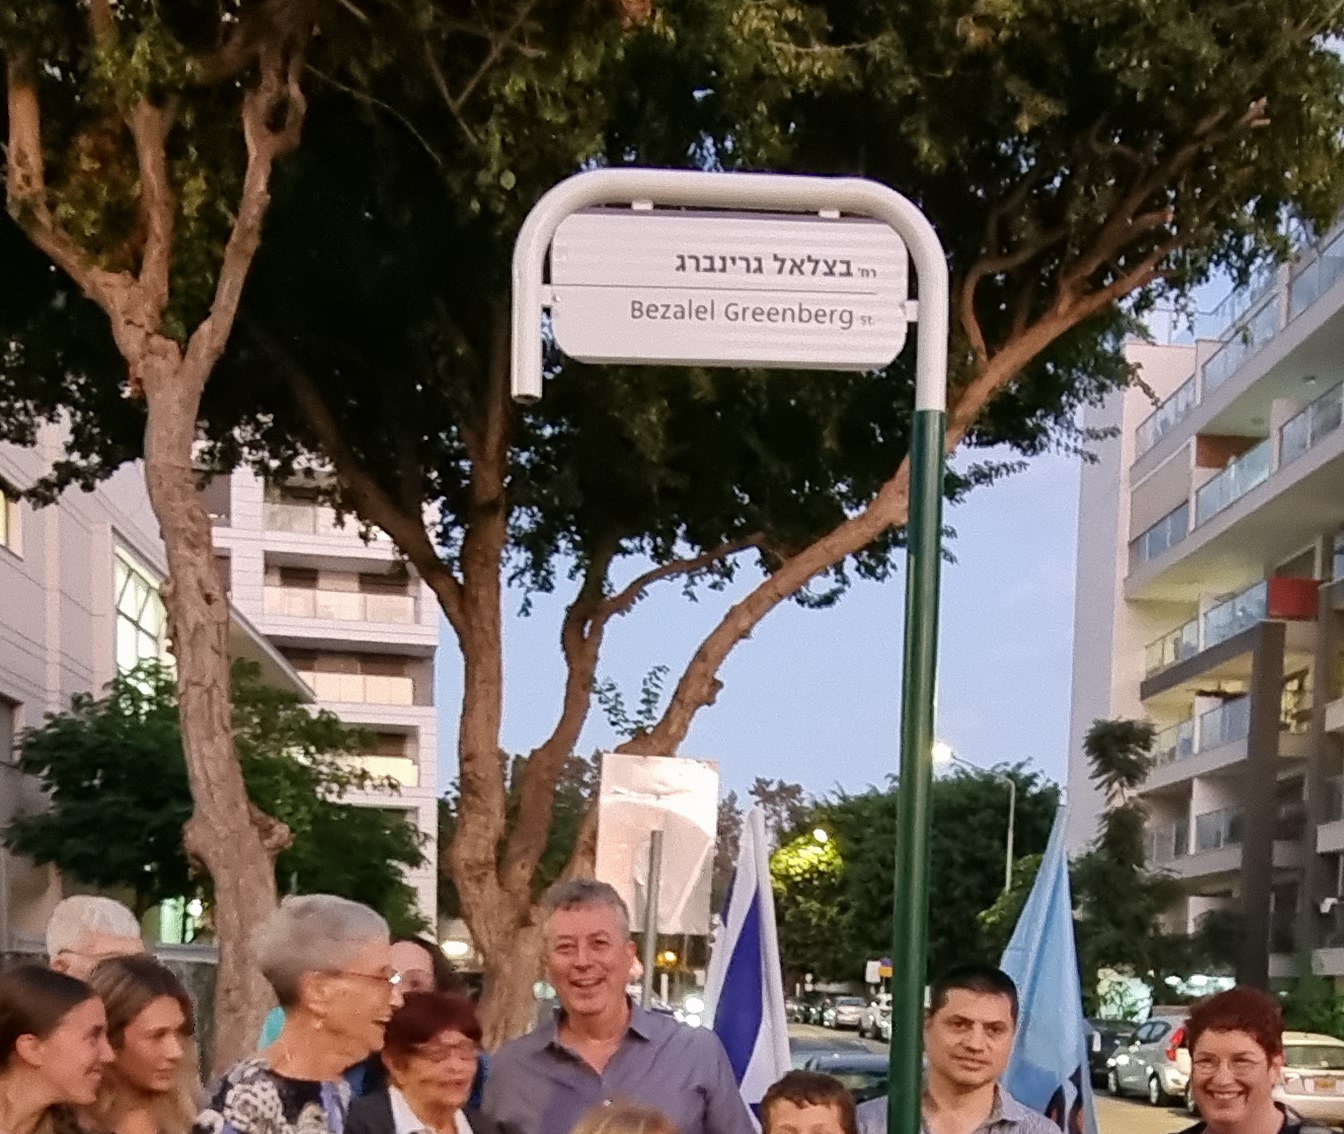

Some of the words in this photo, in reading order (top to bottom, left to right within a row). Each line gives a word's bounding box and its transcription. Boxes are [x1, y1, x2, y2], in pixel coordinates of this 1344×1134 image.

[675, 253, 764, 275] גרינברג
[773, 253, 853, 277] בצלאל
[630, 299, 715, 321] Bezalel
[724, 301, 854, 330] Greenberg
